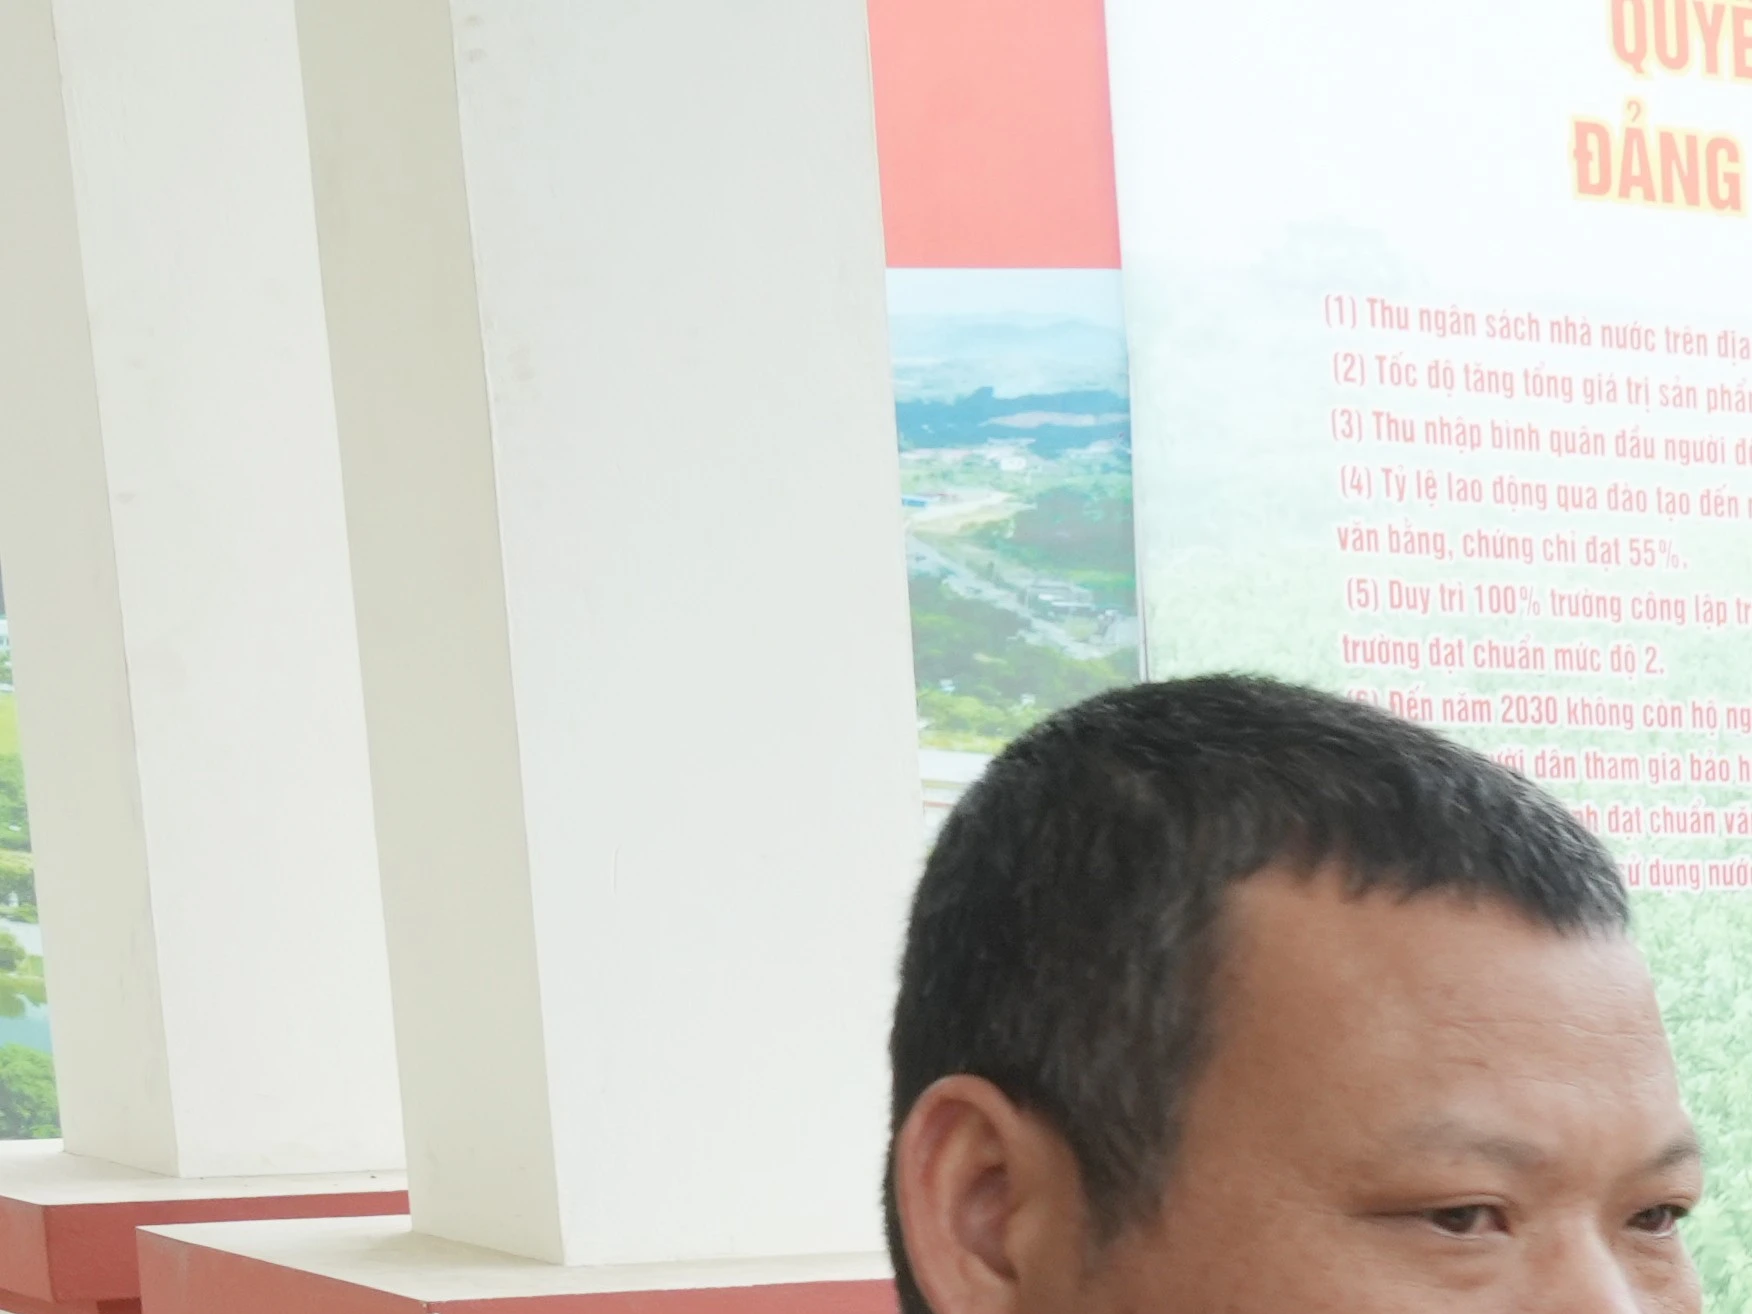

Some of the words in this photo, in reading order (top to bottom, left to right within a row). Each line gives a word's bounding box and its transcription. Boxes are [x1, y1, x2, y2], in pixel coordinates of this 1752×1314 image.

[1569, 96, 1746, 214] ĐẢNG
[1324, 294, 1357, 328] (1)
[1368, 297, 1410, 330] Thu
[1418, 304, 1476, 338] ngân
[1485, 310, 1541, 342] sách
[1549, 315, 1592, 346] nhà
[1600, 321, 1656, 352] nước
[1664, 326, 1708, 356] trên
[1716, 330, 1751, 365] địa
[1332, 352, 1367, 386] (2)
[1374, 352, 1419, 387] Tốc
[1426, 359, 1456, 397] độ
[1462, 363, 1516, 399] tăng
[1521, 362, 1574, 403] tổng
[1581, 373, 1619, 405] giá
[1625, 376, 1651, 412] trị
[1658, 376, 1699, 408] sản
[1330, 408, 1363, 442] (3)
[1374, 410, 1416, 443] Thu
[1424, 416, 1482, 453] nhập
[1490, 419, 1541, 451] bình
[1549, 426, 1606, 457] quân
[1614, 425, 1656, 459] đầu
[1664, 436, 1726, 466] người
[1340, 465, 1372, 499] (4)
[1383, 464, 1406, 502] Tỷ
[1416, 469, 1437, 506] lệ
[1447, 472, 1483, 503] lao
[1492, 475, 1547, 511] động
[1556, 484, 1597, 512] qua
[1606, 482, 1647, 512] đào
[1656, 486, 1690, 521] tạo
[1699, 484, 1739, 518] đến
[1337, 522, 1379, 552] văn
[1388, 520, 1453, 560] bằng,
[1462, 529, 1533, 564] chứng
[1542, 531, 1575, 562] chỉ
[1585, 535, 1620, 570] đạt
[1630, 538, 1688, 569] 55%.
[1536, 749, 1576, 780] dân
[1584, 751, 1640, 780] tham
[1647, 752, 1682, 784] gia
[1689, 752, 1731, 782] bảo
